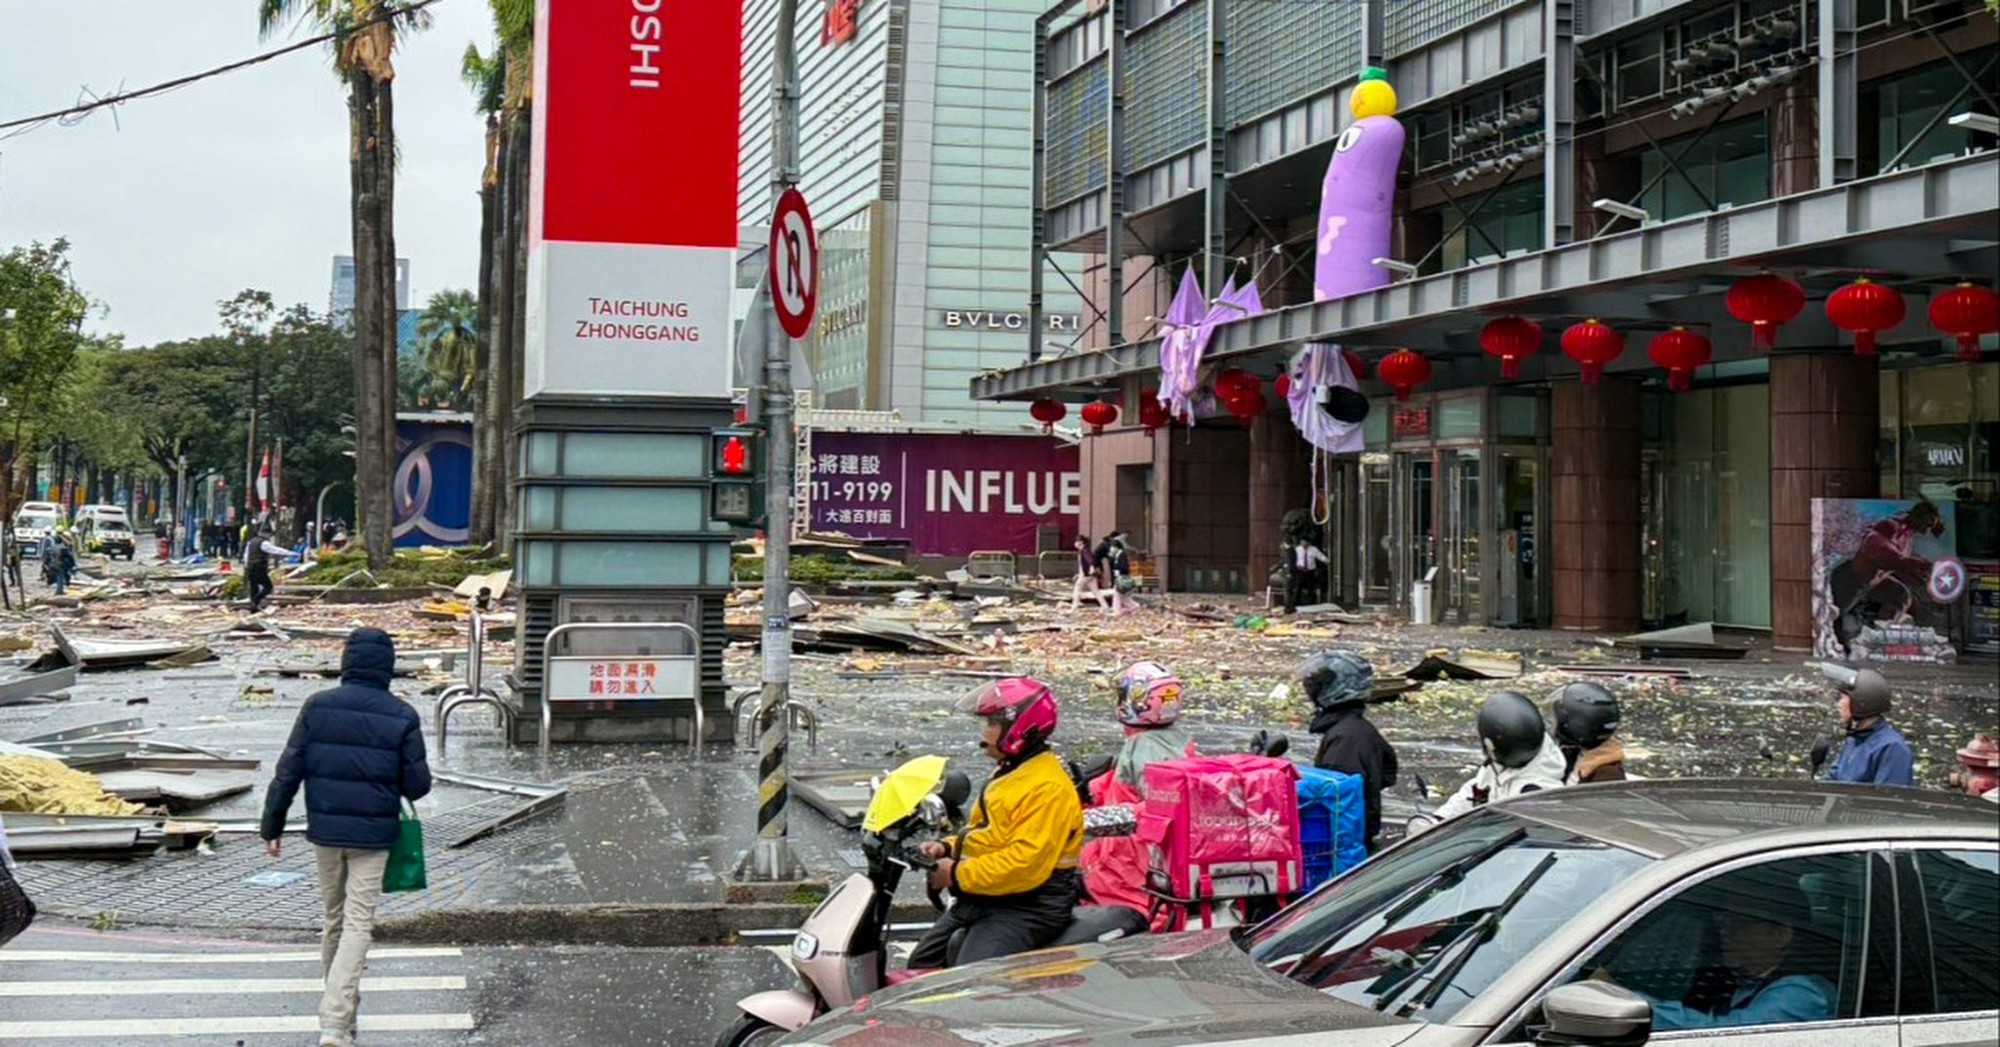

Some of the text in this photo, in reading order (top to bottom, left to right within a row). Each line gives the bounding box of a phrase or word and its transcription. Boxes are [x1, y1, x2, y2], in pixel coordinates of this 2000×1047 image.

[588, 297, 689, 318] TAICHUNG
[575, 320, 700, 342] ZHONGGANG
[946, 311, 1078, 330] BVLGRI
[926, 469, 1080, 515] INFLUE
[589, 680, 656, 694] 請勿進入
